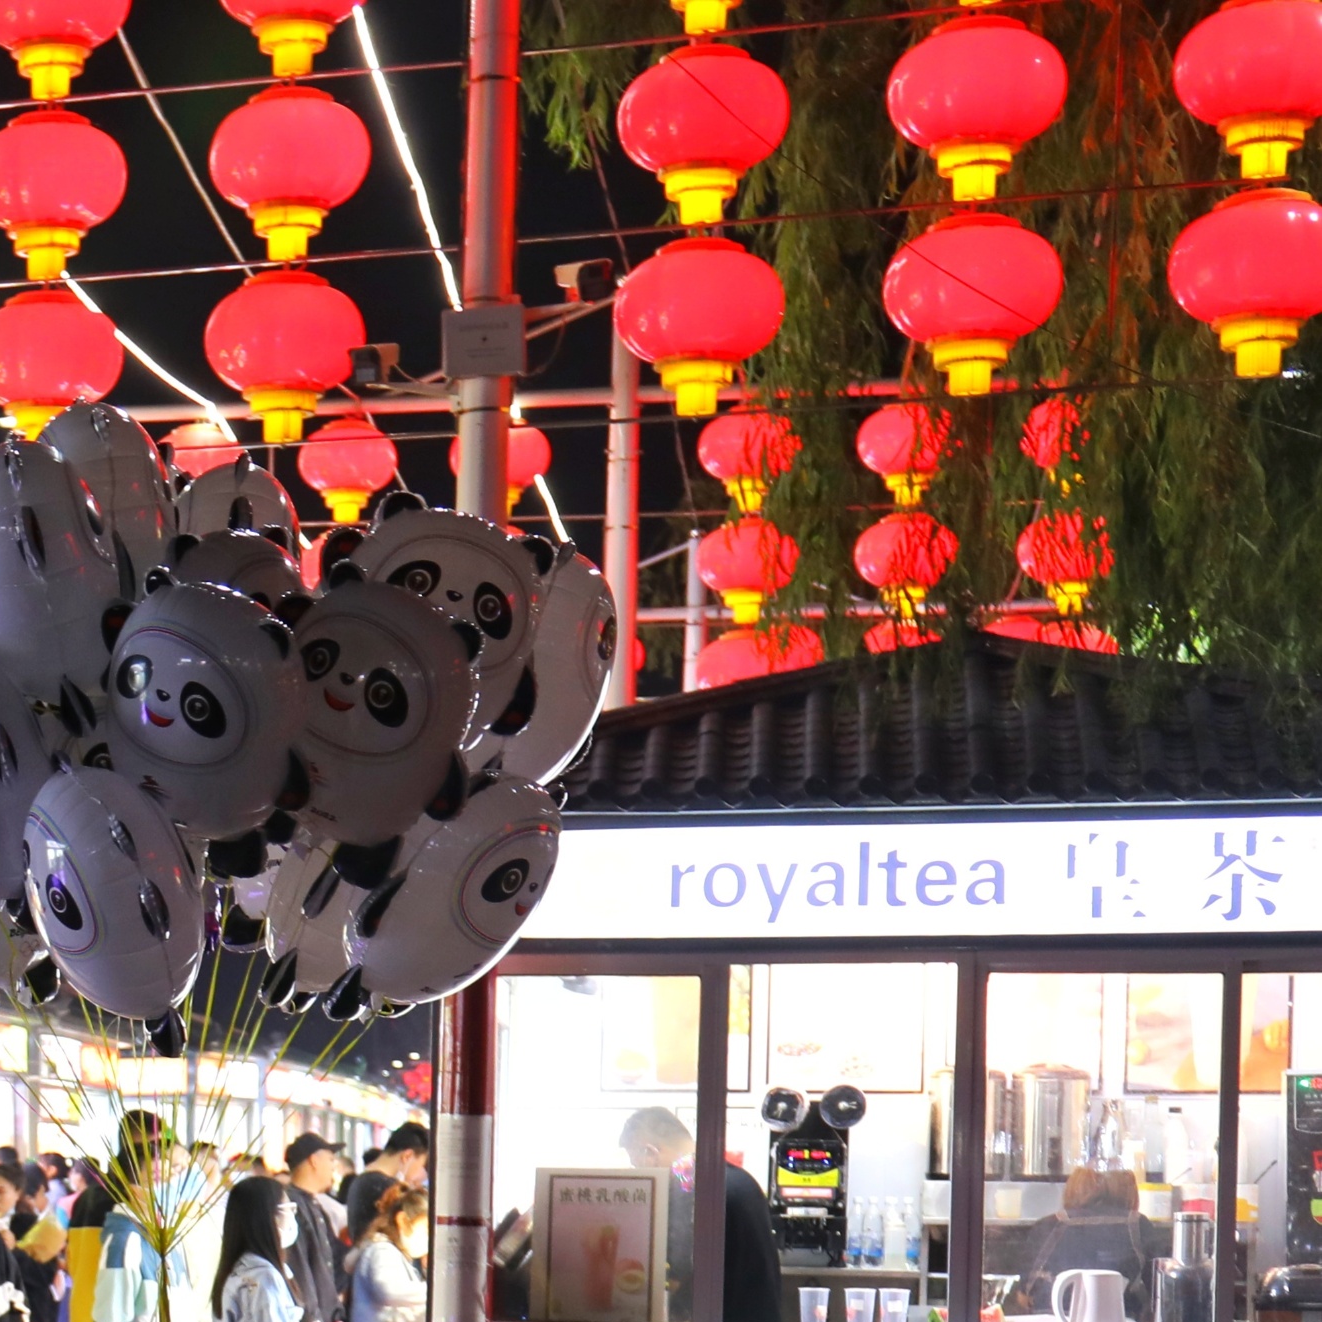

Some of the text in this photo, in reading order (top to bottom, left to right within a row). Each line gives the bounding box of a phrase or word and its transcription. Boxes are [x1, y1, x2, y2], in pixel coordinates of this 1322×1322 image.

[670, 841, 1007, 923] royaltea
[559, 1186, 648, 1205] 蜜桃乳酸菌
